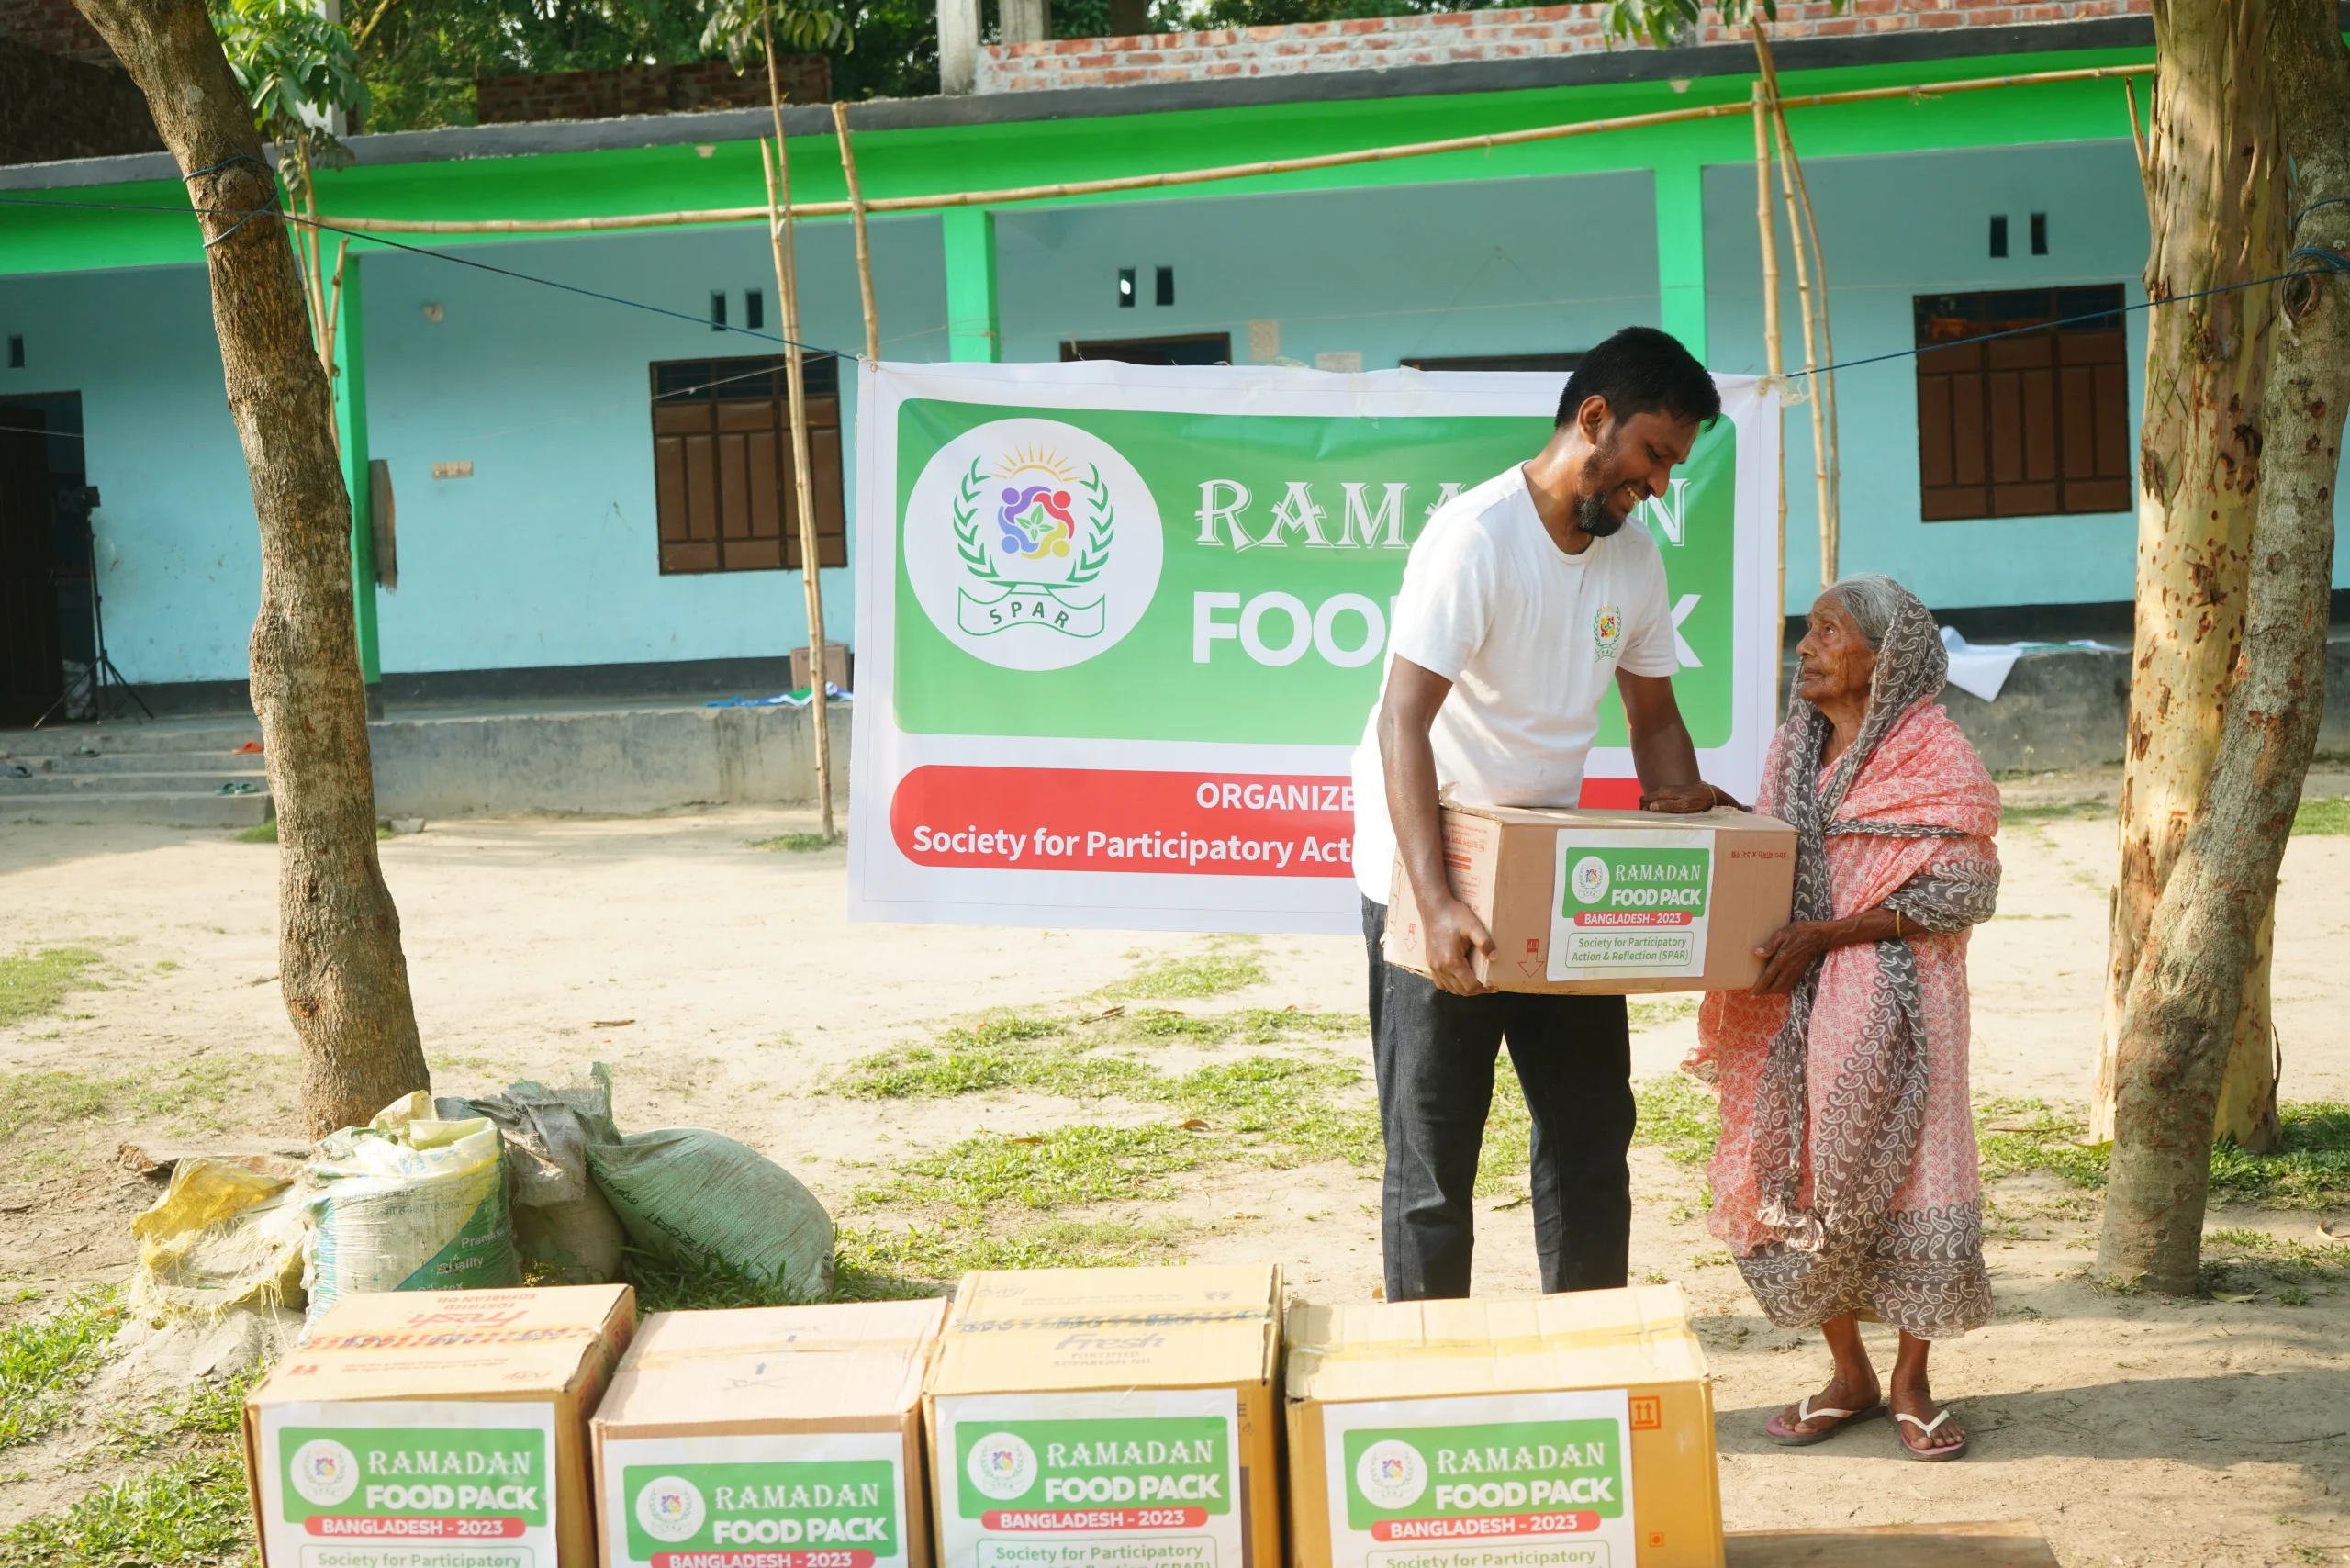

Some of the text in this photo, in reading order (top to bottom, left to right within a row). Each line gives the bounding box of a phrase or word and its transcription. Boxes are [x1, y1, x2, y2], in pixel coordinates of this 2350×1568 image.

[989, 601, 1069, 628] SPAR
[1193, 591, 1401, 667] FOO
[1196, 782, 1354, 811] ORGANIZE
[913, 826, 1351, 868] Society for Participatory Act
[1615, 865, 1701, 882] RAMADAN
[1611, 888, 1702, 906] FOOD PACK
[1584, 913, 1650, 924] BANGLADESH
[1657, 913, 1681, 924] 2023
[1578, 936, 1686, 949] Society for Participatory
[1572, 950, 1688, 962] Action & Reflection (SPAR)
[407, 1310, 529, 1329] Fresh
[1055, 1332, 1167, 1351] Fresh
[369, 1450, 531, 1476] RAMADAN
[1047, 1440, 1214, 1469] RAMADAN
[1438, 1442, 1605, 1474] RAMADAN
[366, 1484, 539, 1511] FOOD PACK
[714, 1484, 879, 1511] RAMADAN
[1045, 1473, 1222, 1503] FOOD PACK
[1436, 1477, 1615, 1510] FOOD PACK
[322, 1519, 443, 1535] BANGLADESH
[457, 1520, 504, 1535] 2023
[1001, 1512, 1124, 1529] BANGLADESH
[1138, 1510, 1185, 1526] 2023
[1391, 1518, 1515, 1539] BANGLADESH
[1530, 1514, 1578, 1532] 2023
[713, 1517, 889, 1545] FOOD PACK
[319, 1553, 521, 1568] Society for Participatory
[669, 1553, 785, 1568] BANGLADESH
[809, 1551, 853, 1568] 2023
[996, 1544, 1203, 1563] Society for Participatory
[1386, 1550, 1596, 1568] Society for Participatory
